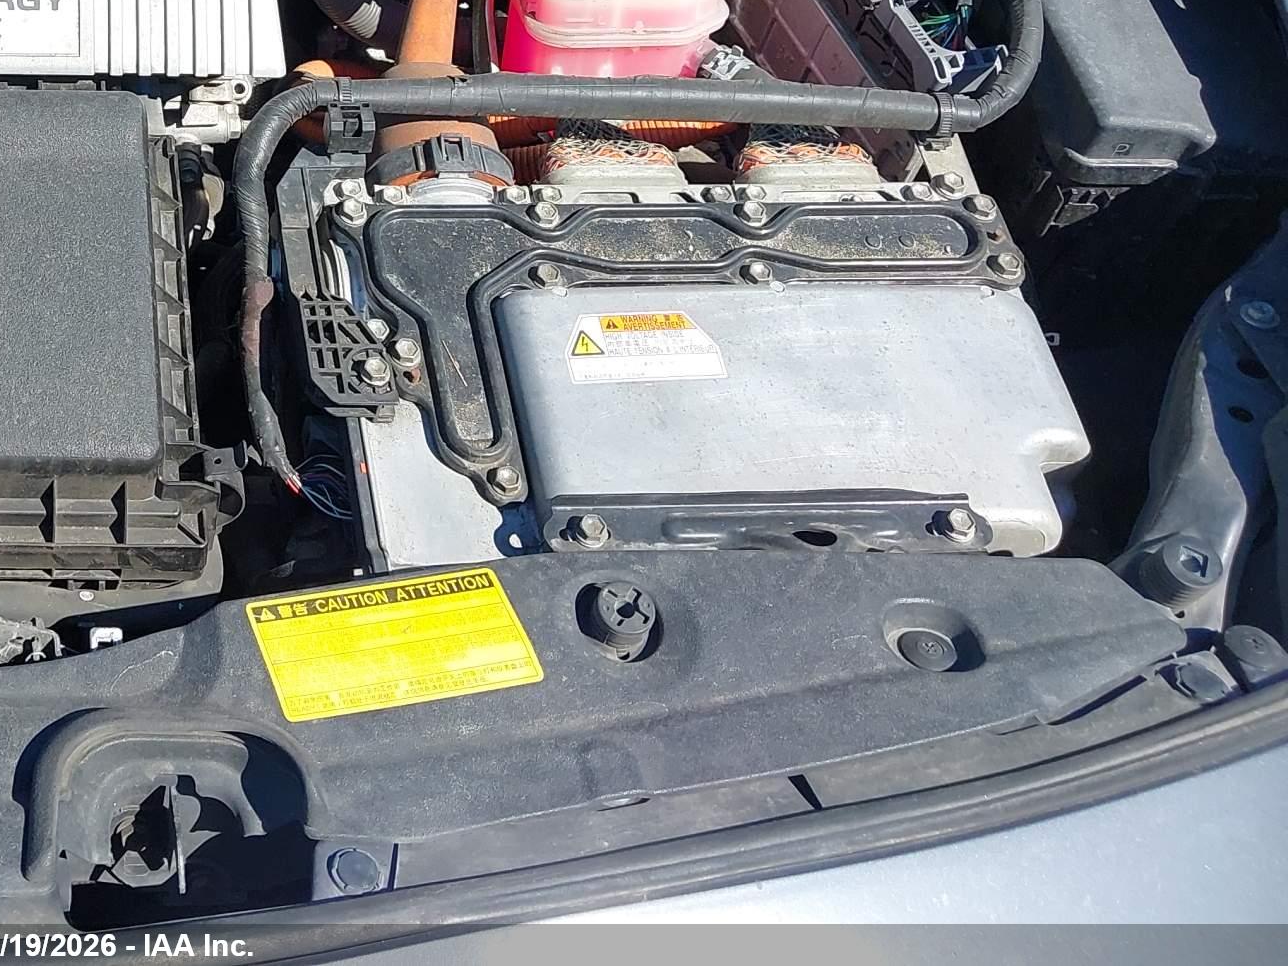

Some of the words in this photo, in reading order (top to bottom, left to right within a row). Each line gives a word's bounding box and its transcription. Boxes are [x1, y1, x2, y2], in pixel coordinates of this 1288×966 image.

[620, 315, 658, 323] WARNING
[623, 321, 686, 331] AVERTISSEMENT
[314, 590, 388, 614] CAUTION
[396, 574, 489, 602] ATTENTION
